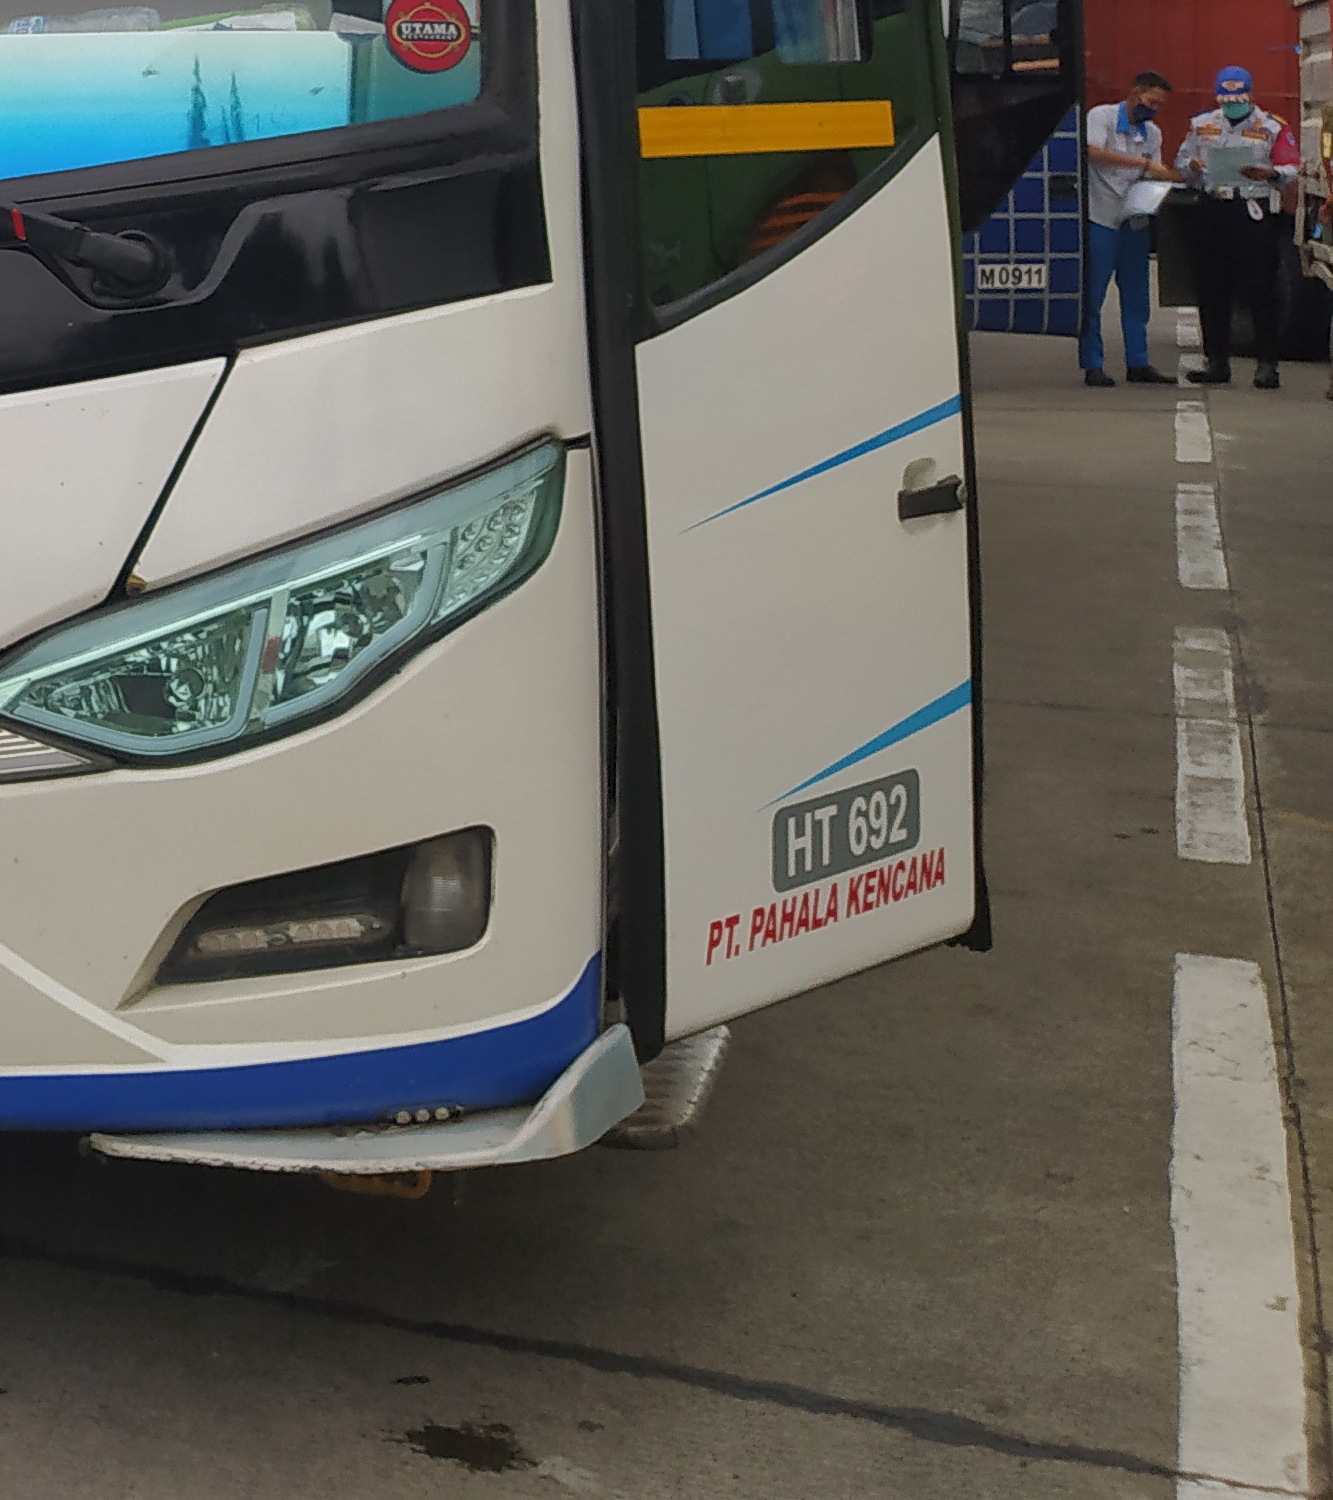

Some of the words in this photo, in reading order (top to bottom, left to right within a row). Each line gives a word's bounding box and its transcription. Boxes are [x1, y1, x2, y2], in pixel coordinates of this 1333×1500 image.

[401, 22, 458, 35] UTAMA
[786, 804, 839, 878] HT
[848, 784, 909, 858] 692
[705, 913, 742, 967] PT.
[748, 881, 840, 952] PAHALA
[846, 846, 946, 919] KENCANA
